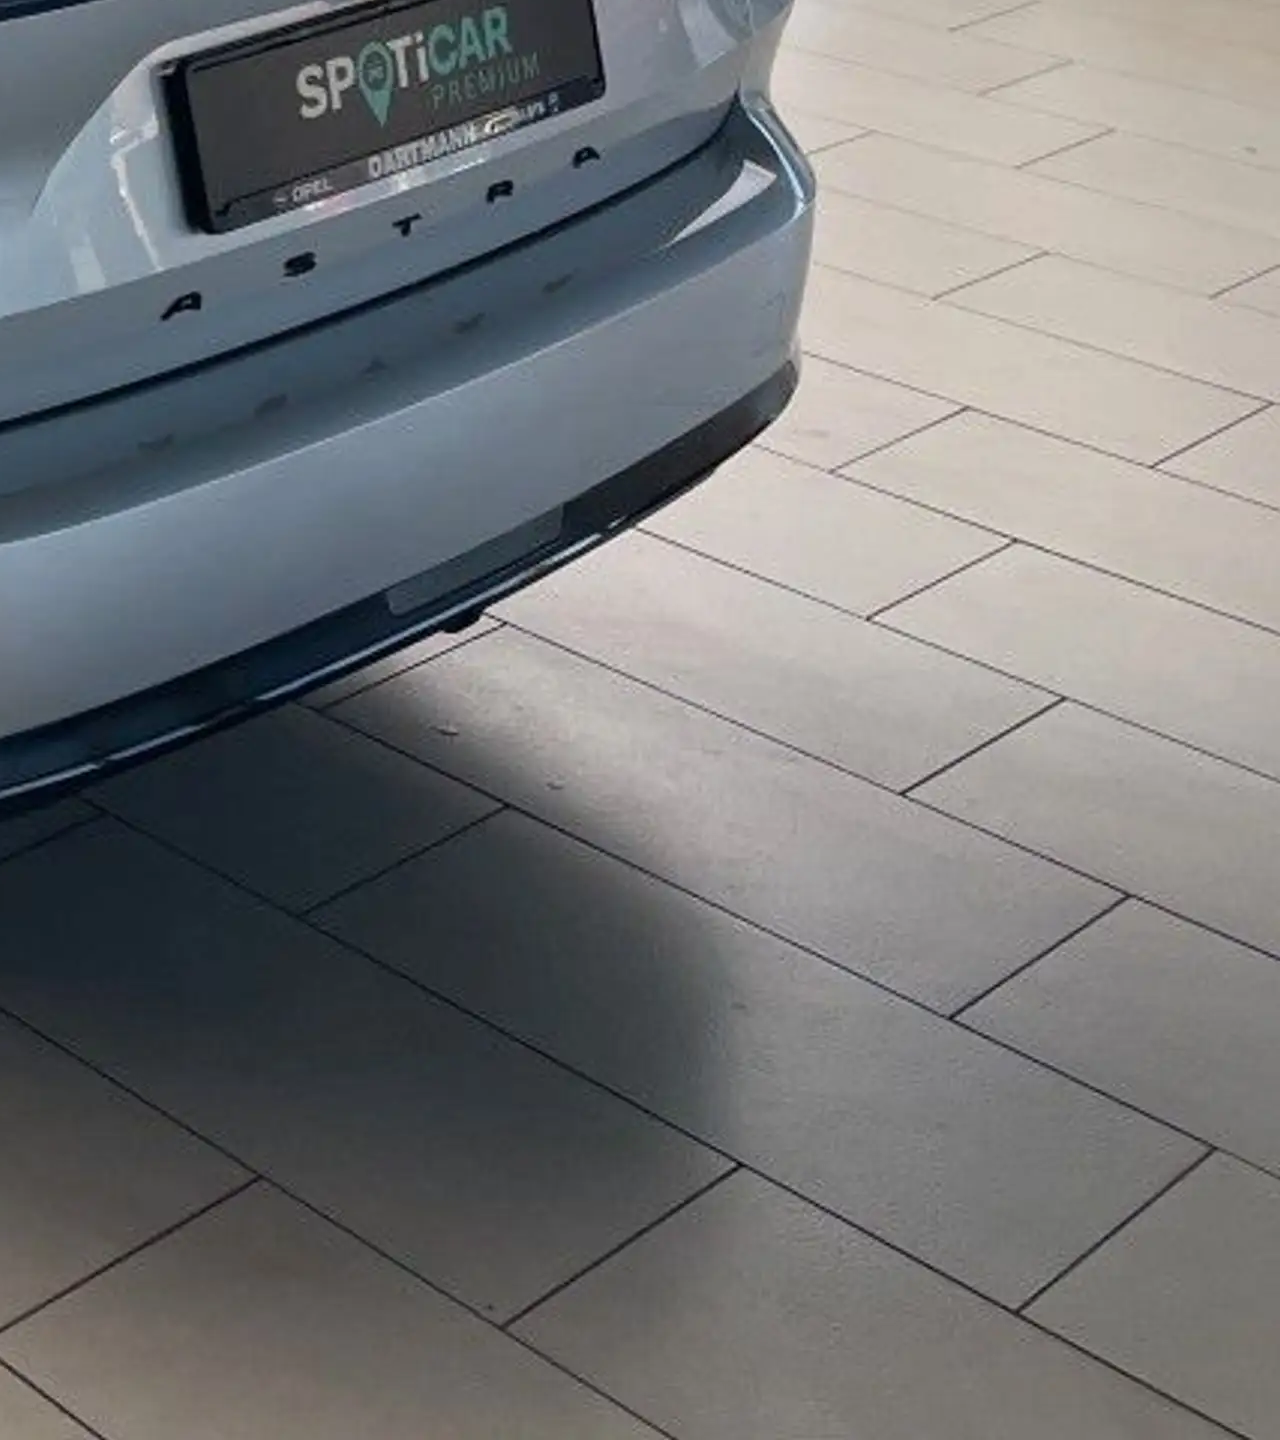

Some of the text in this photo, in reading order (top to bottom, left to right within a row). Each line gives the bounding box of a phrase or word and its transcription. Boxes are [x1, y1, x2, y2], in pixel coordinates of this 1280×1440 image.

[431, 50, 541, 111] PREMIUM
[291, 120, 477, 205] OPEL DARTMANN
[160, 145, 601, 322] ASTRA
